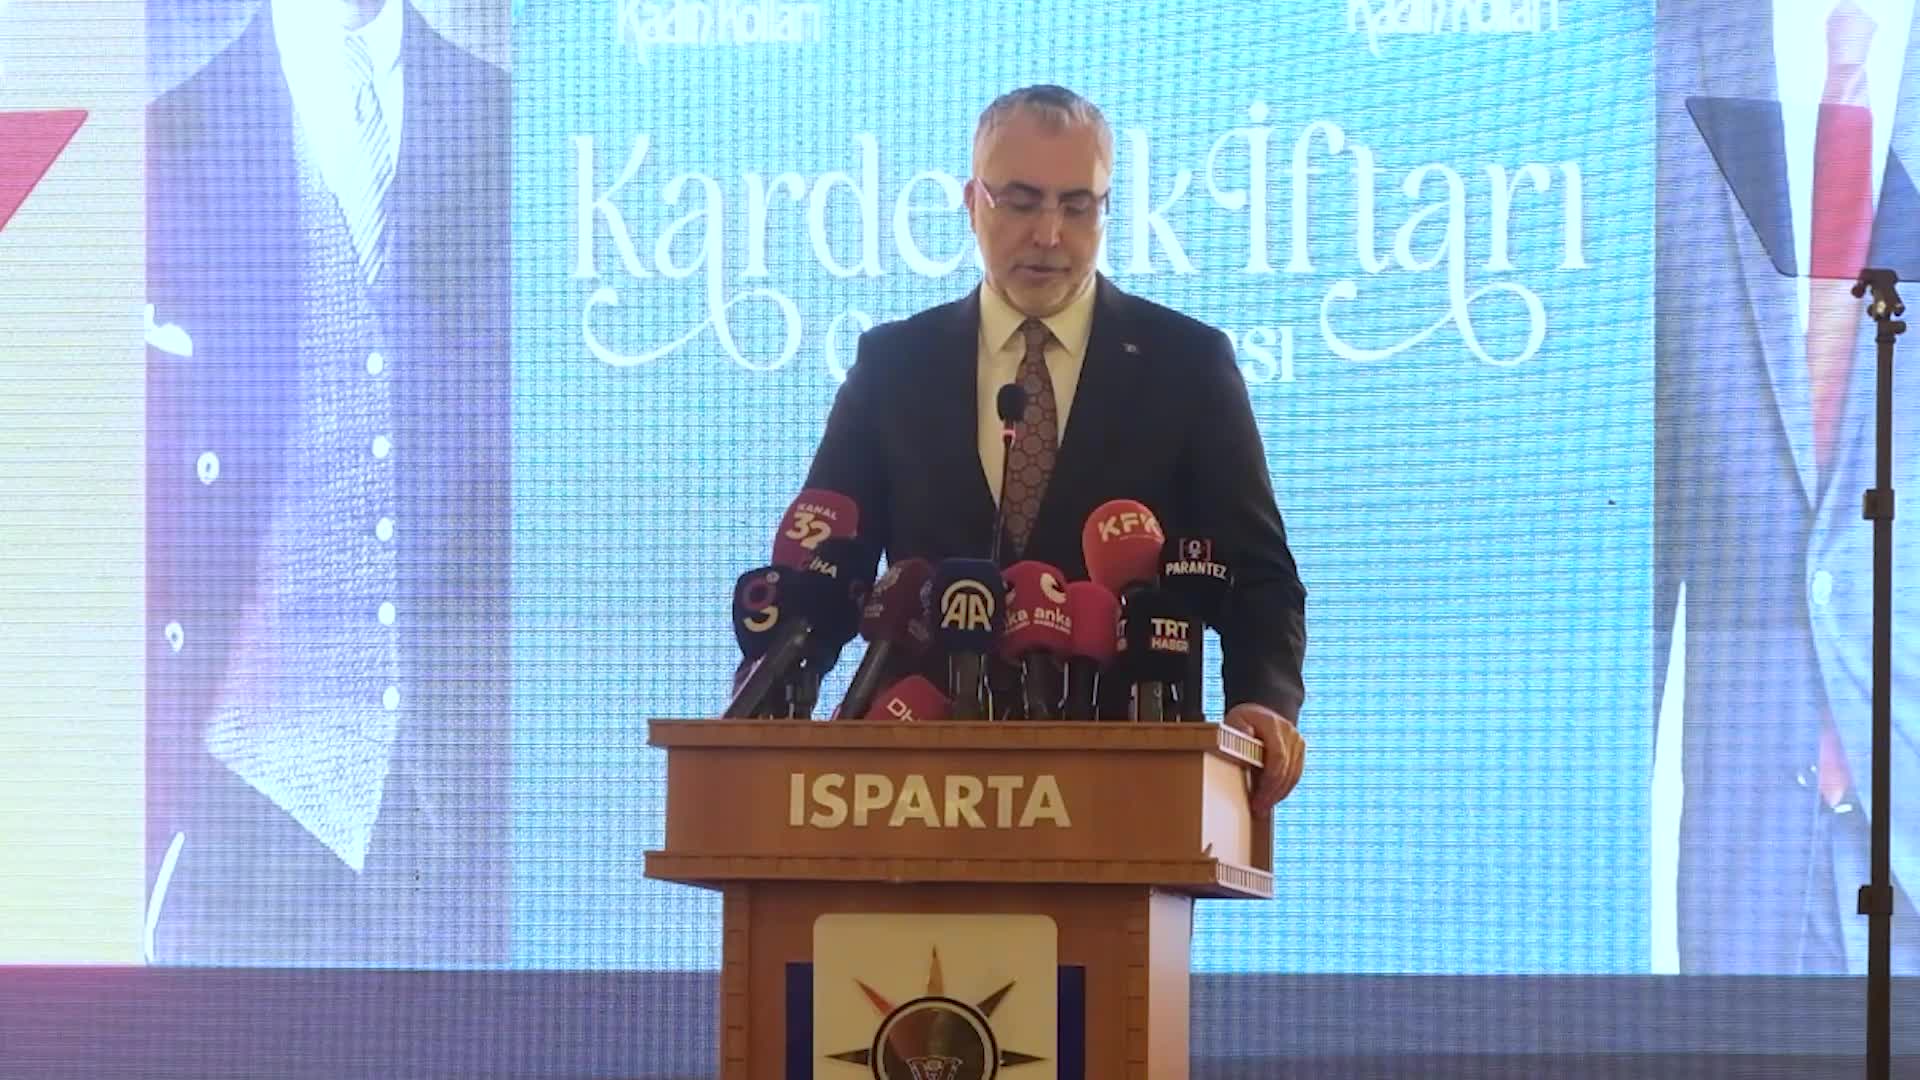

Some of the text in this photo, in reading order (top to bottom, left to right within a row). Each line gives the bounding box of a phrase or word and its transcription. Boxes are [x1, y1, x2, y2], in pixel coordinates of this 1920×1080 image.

[1205, 100, 1589, 368] İftarı
[796, 503, 837, 521] KANAL
[784, 511, 832, 550] 32
[1165, 560, 1228, 580] PARANTEZ
[940, 590, 993, 632] AA
[1150, 617, 1190, 640] TRT
[1151, 636, 1190, 653] HABER
[788, 772, 1073, 830] ISPARTA
